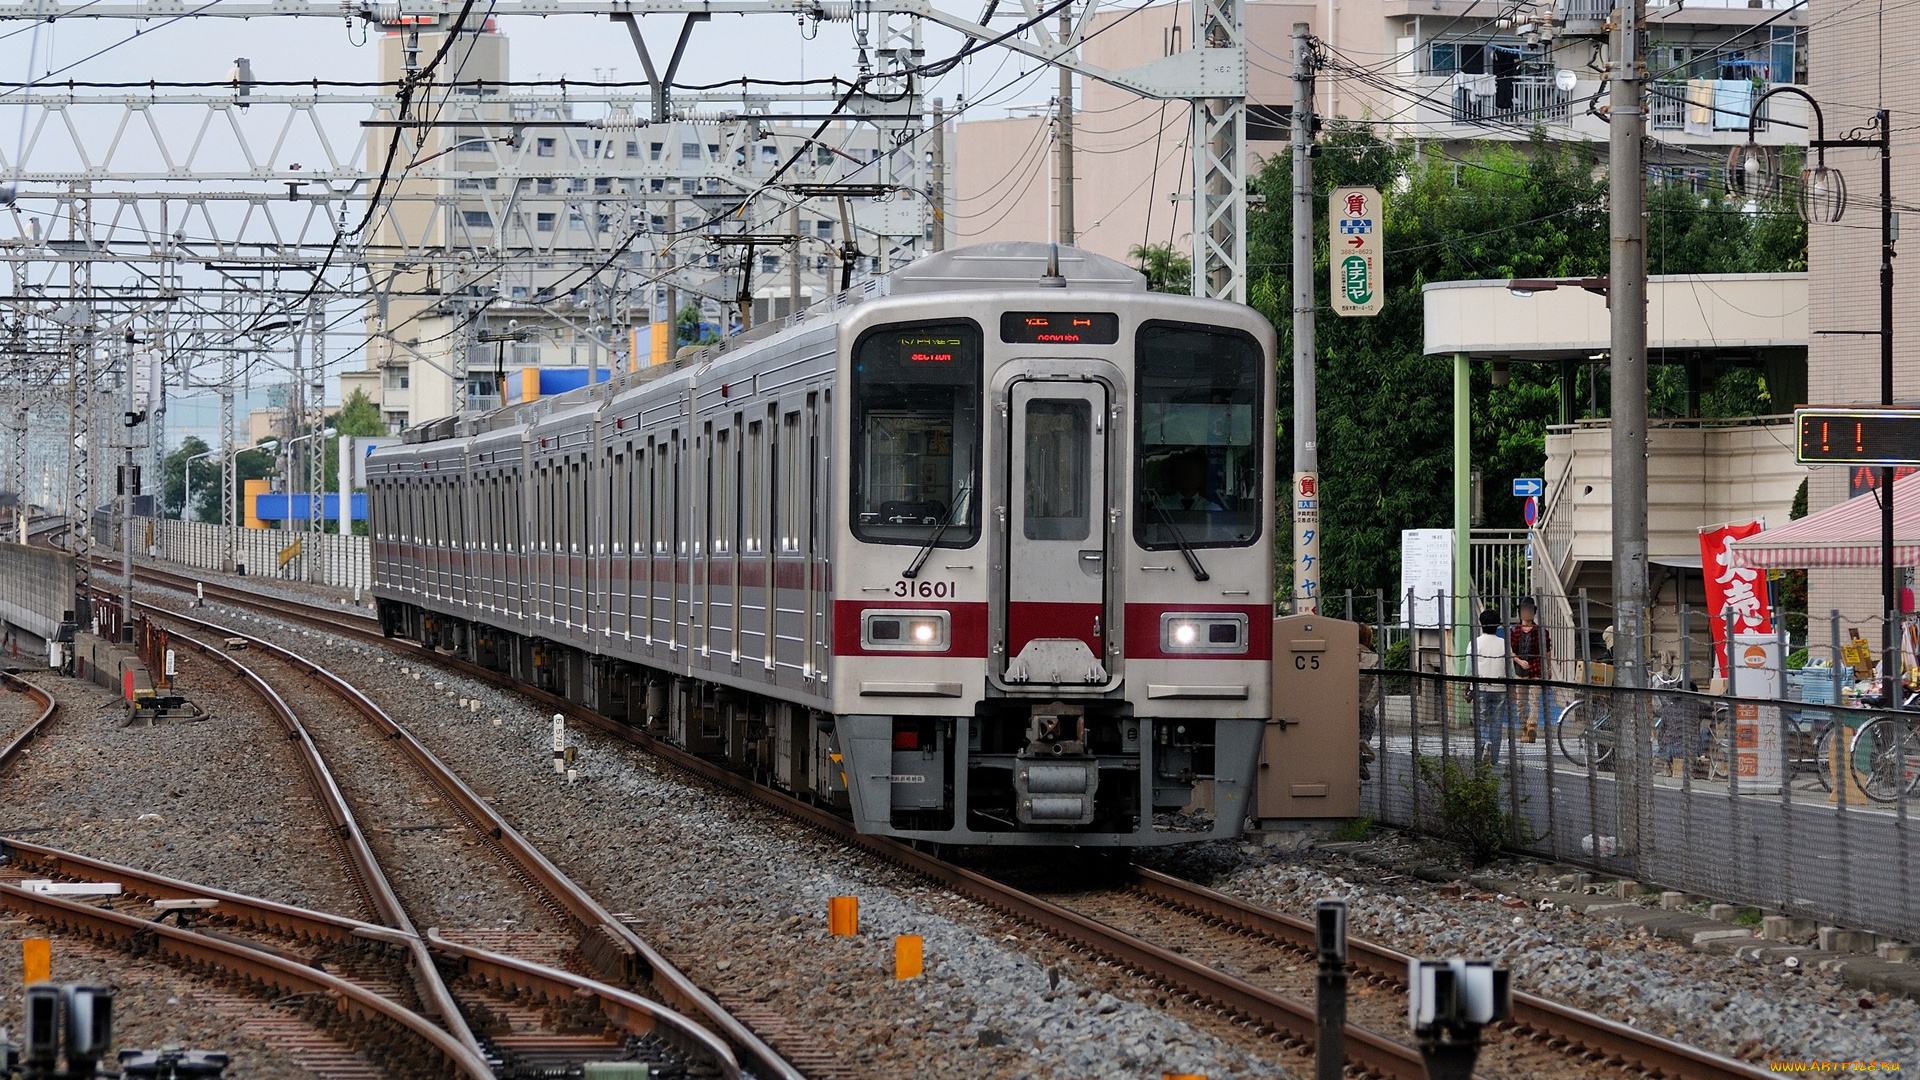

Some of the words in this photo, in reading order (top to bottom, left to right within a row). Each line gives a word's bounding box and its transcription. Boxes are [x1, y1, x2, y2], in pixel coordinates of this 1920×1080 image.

[1347, 194, 1365, 216] 質
[1348, 260, 1366, 300] エチゴヤ
[1300, 479, 1315, 496] 質
[1301, 529, 1317, 597] タケヤ
[894, 580, 955, 598] 31601
